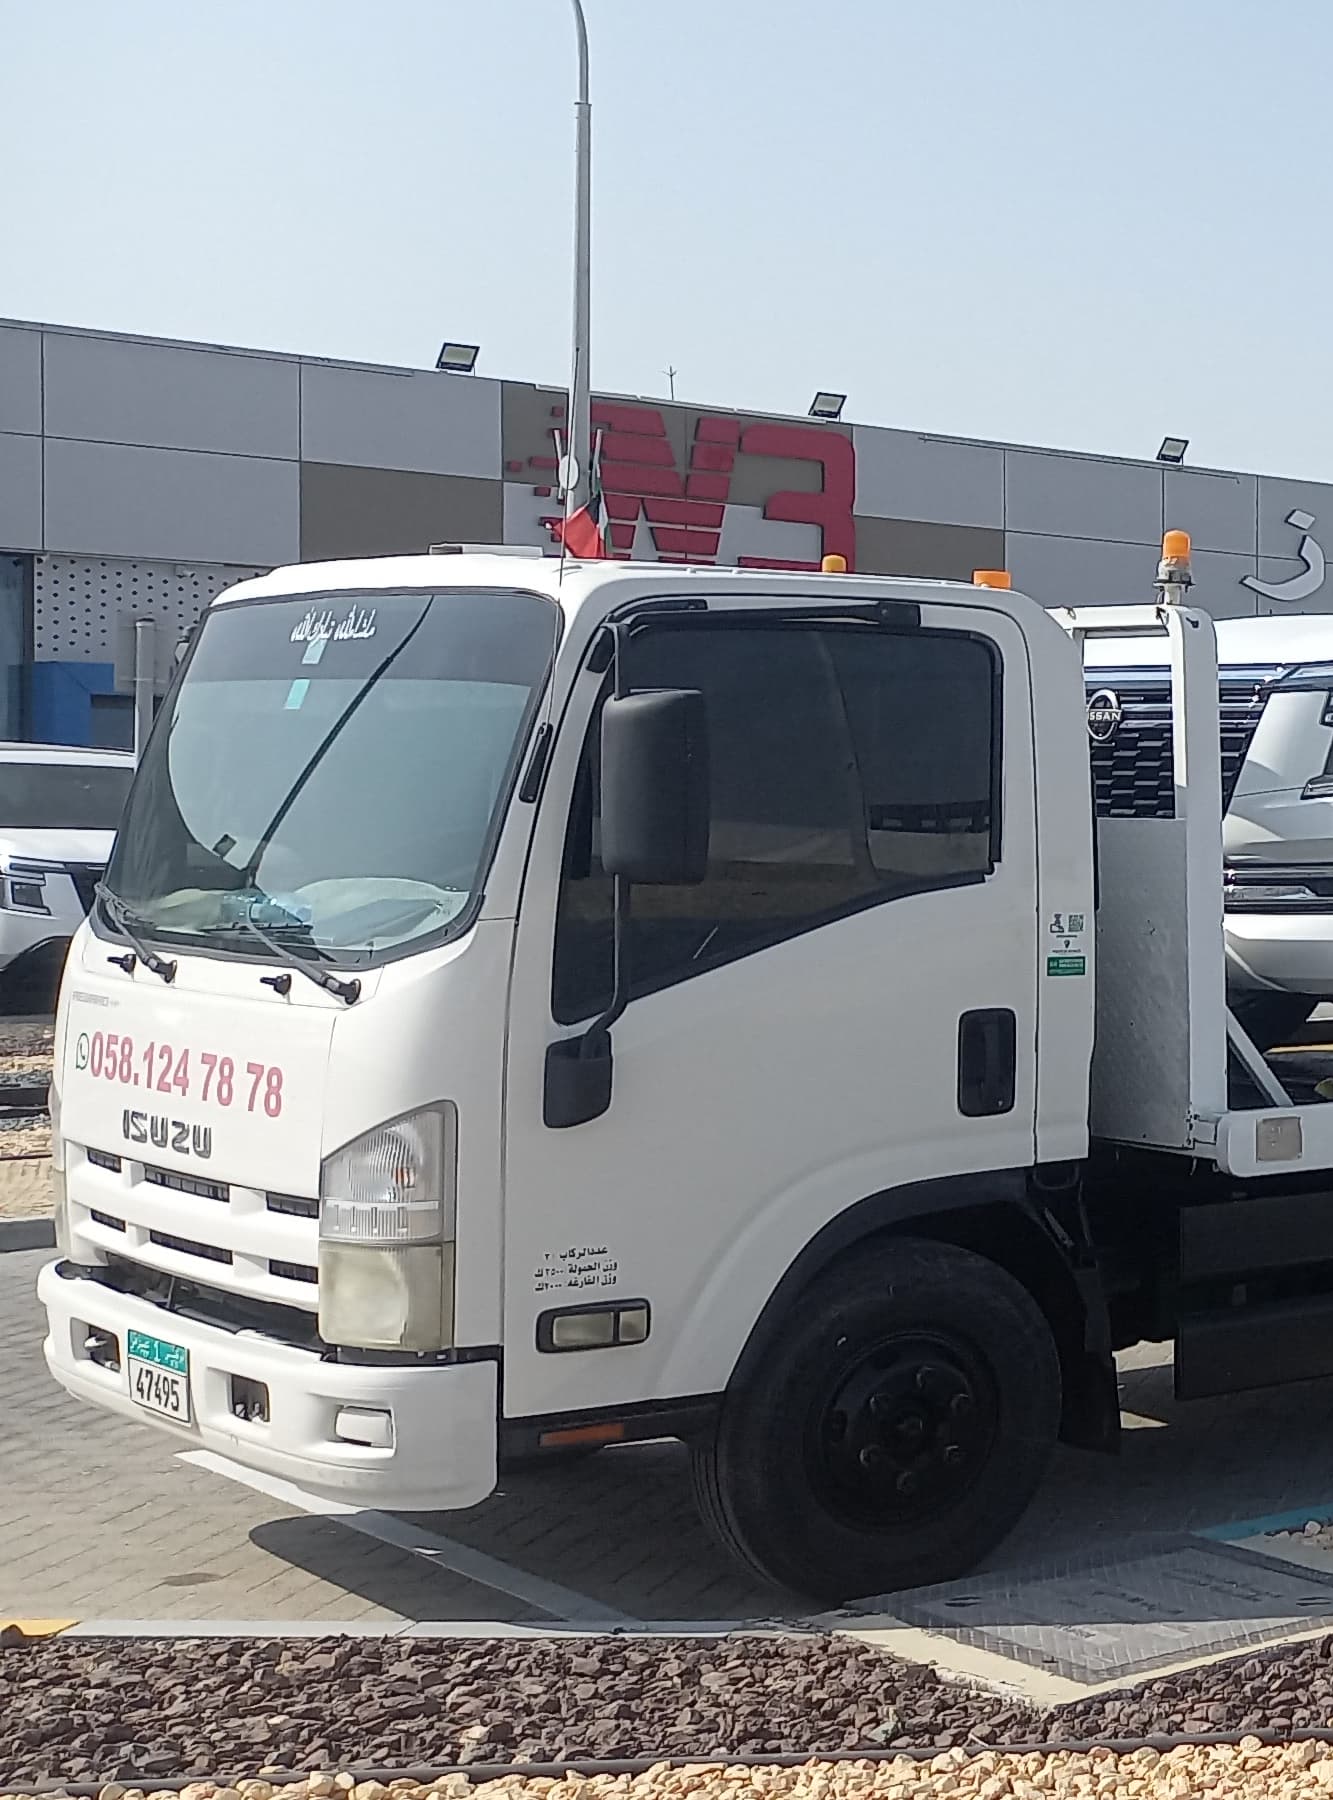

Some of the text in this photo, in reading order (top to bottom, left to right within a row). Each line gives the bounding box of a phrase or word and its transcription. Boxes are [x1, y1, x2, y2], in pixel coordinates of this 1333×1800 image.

[1088, 711, 1121, 721] SSAN
[90, 1031, 284, 1118] 058.124 78 78
[122, 1109, 212, 1159] ISUZU
[136, 1367, 180, 1412] 47495
